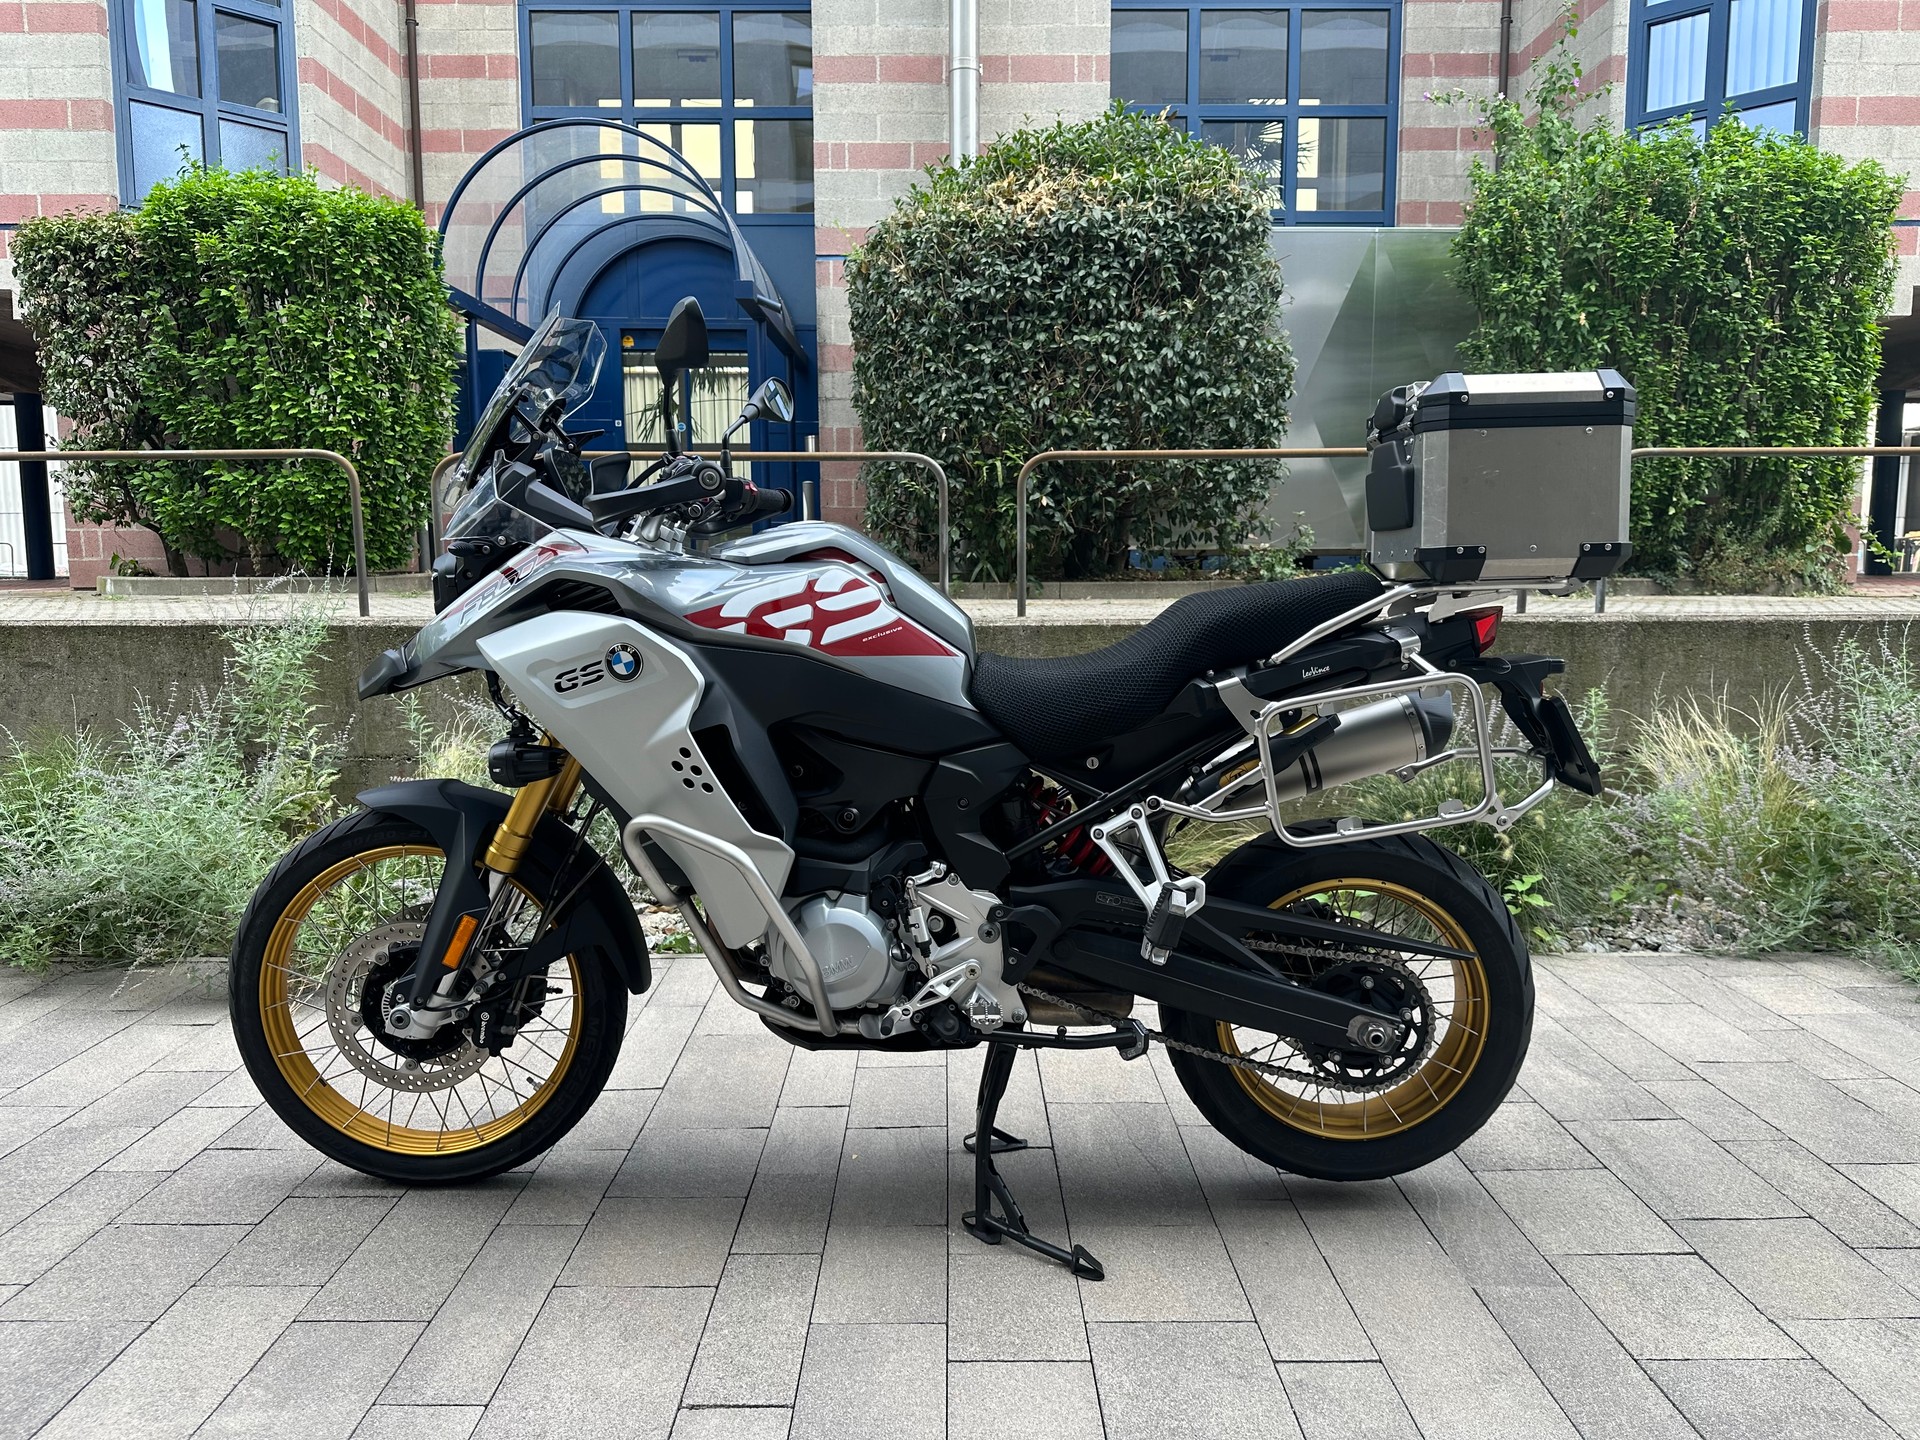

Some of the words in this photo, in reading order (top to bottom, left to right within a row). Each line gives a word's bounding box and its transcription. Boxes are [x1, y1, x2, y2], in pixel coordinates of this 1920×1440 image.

[716, 567, 900, 646] GS
[862, 626, 903, 642] exclusive
[554, 660, 605, 694] GS
